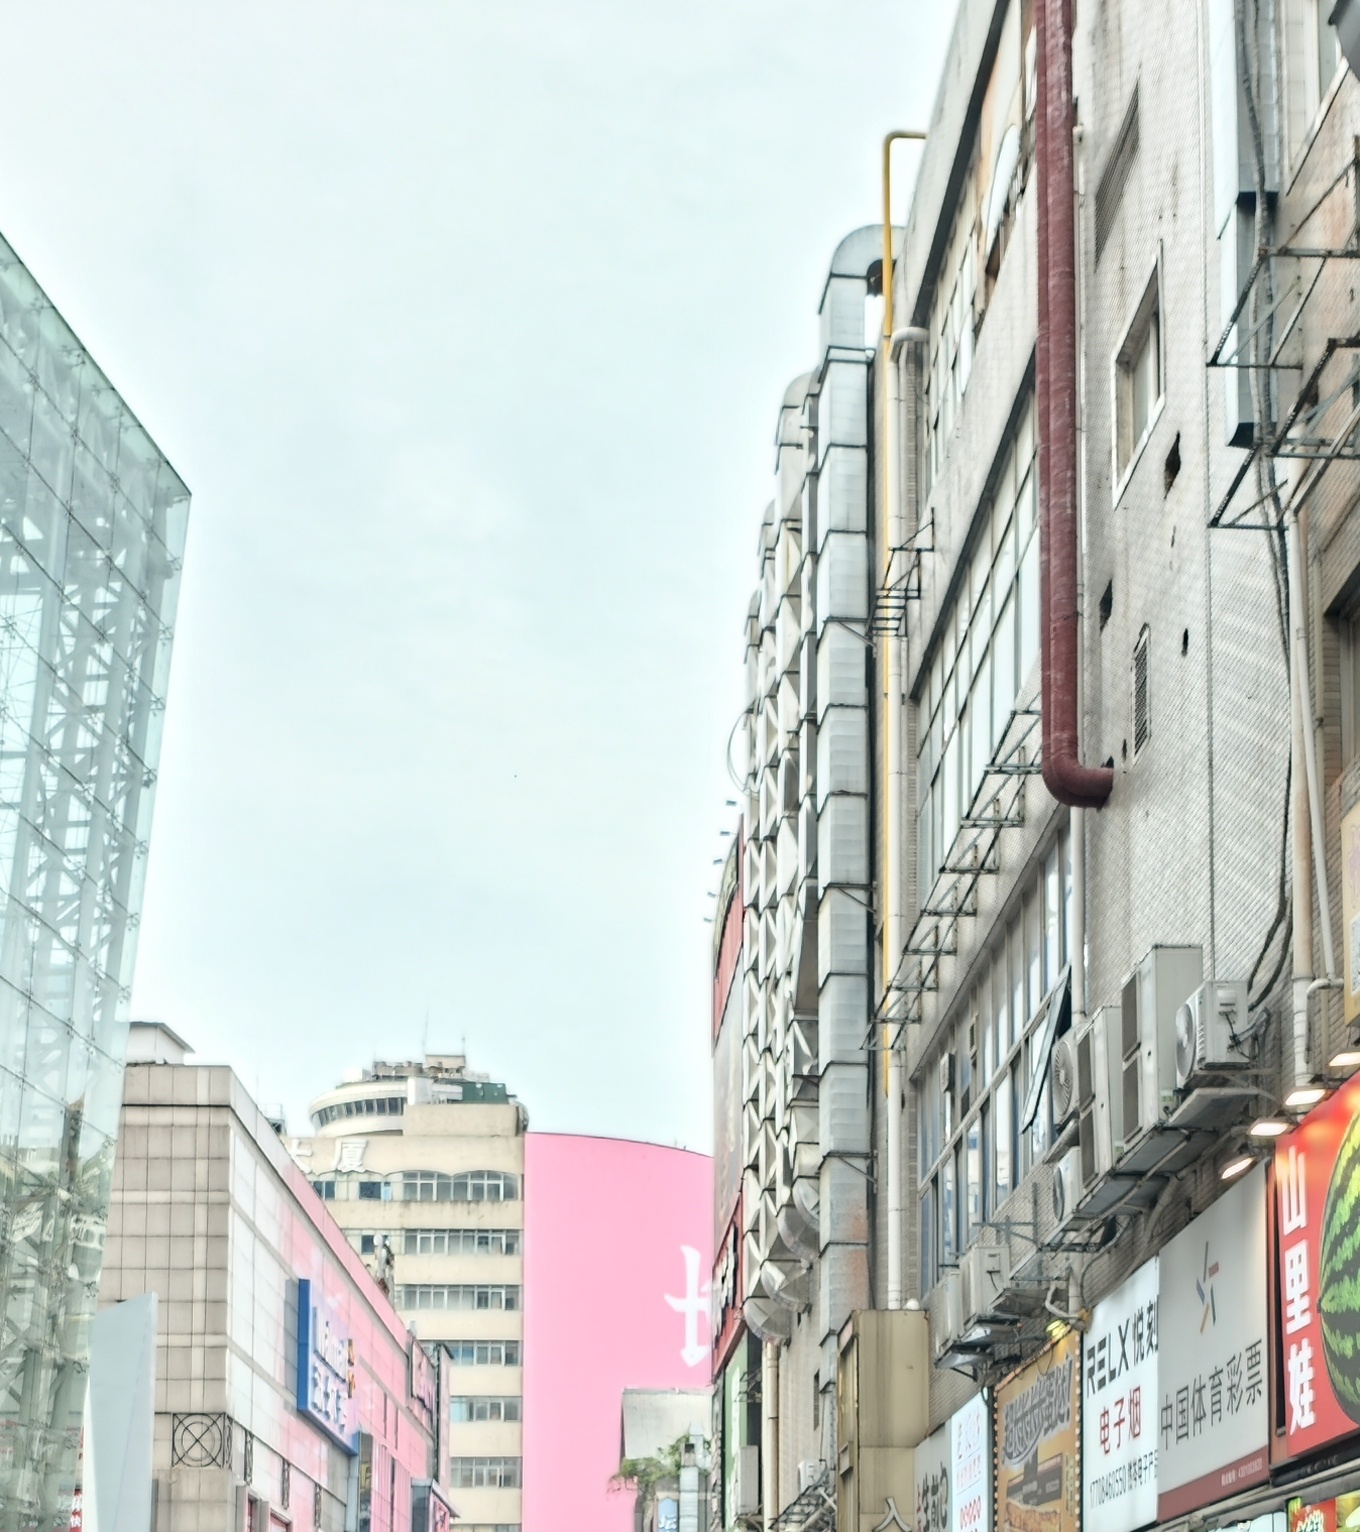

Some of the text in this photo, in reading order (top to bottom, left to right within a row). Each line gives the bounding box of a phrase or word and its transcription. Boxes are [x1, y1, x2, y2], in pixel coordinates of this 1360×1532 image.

[1275, 1145, 1317, 1437] 山里娃
[1086, 1298, 1159, 1399] RELX 悦刻
[1160, 1338, 1263, 1451] 中国体育彩票
[1099, 1385, 1142, 1456] 电子烟
